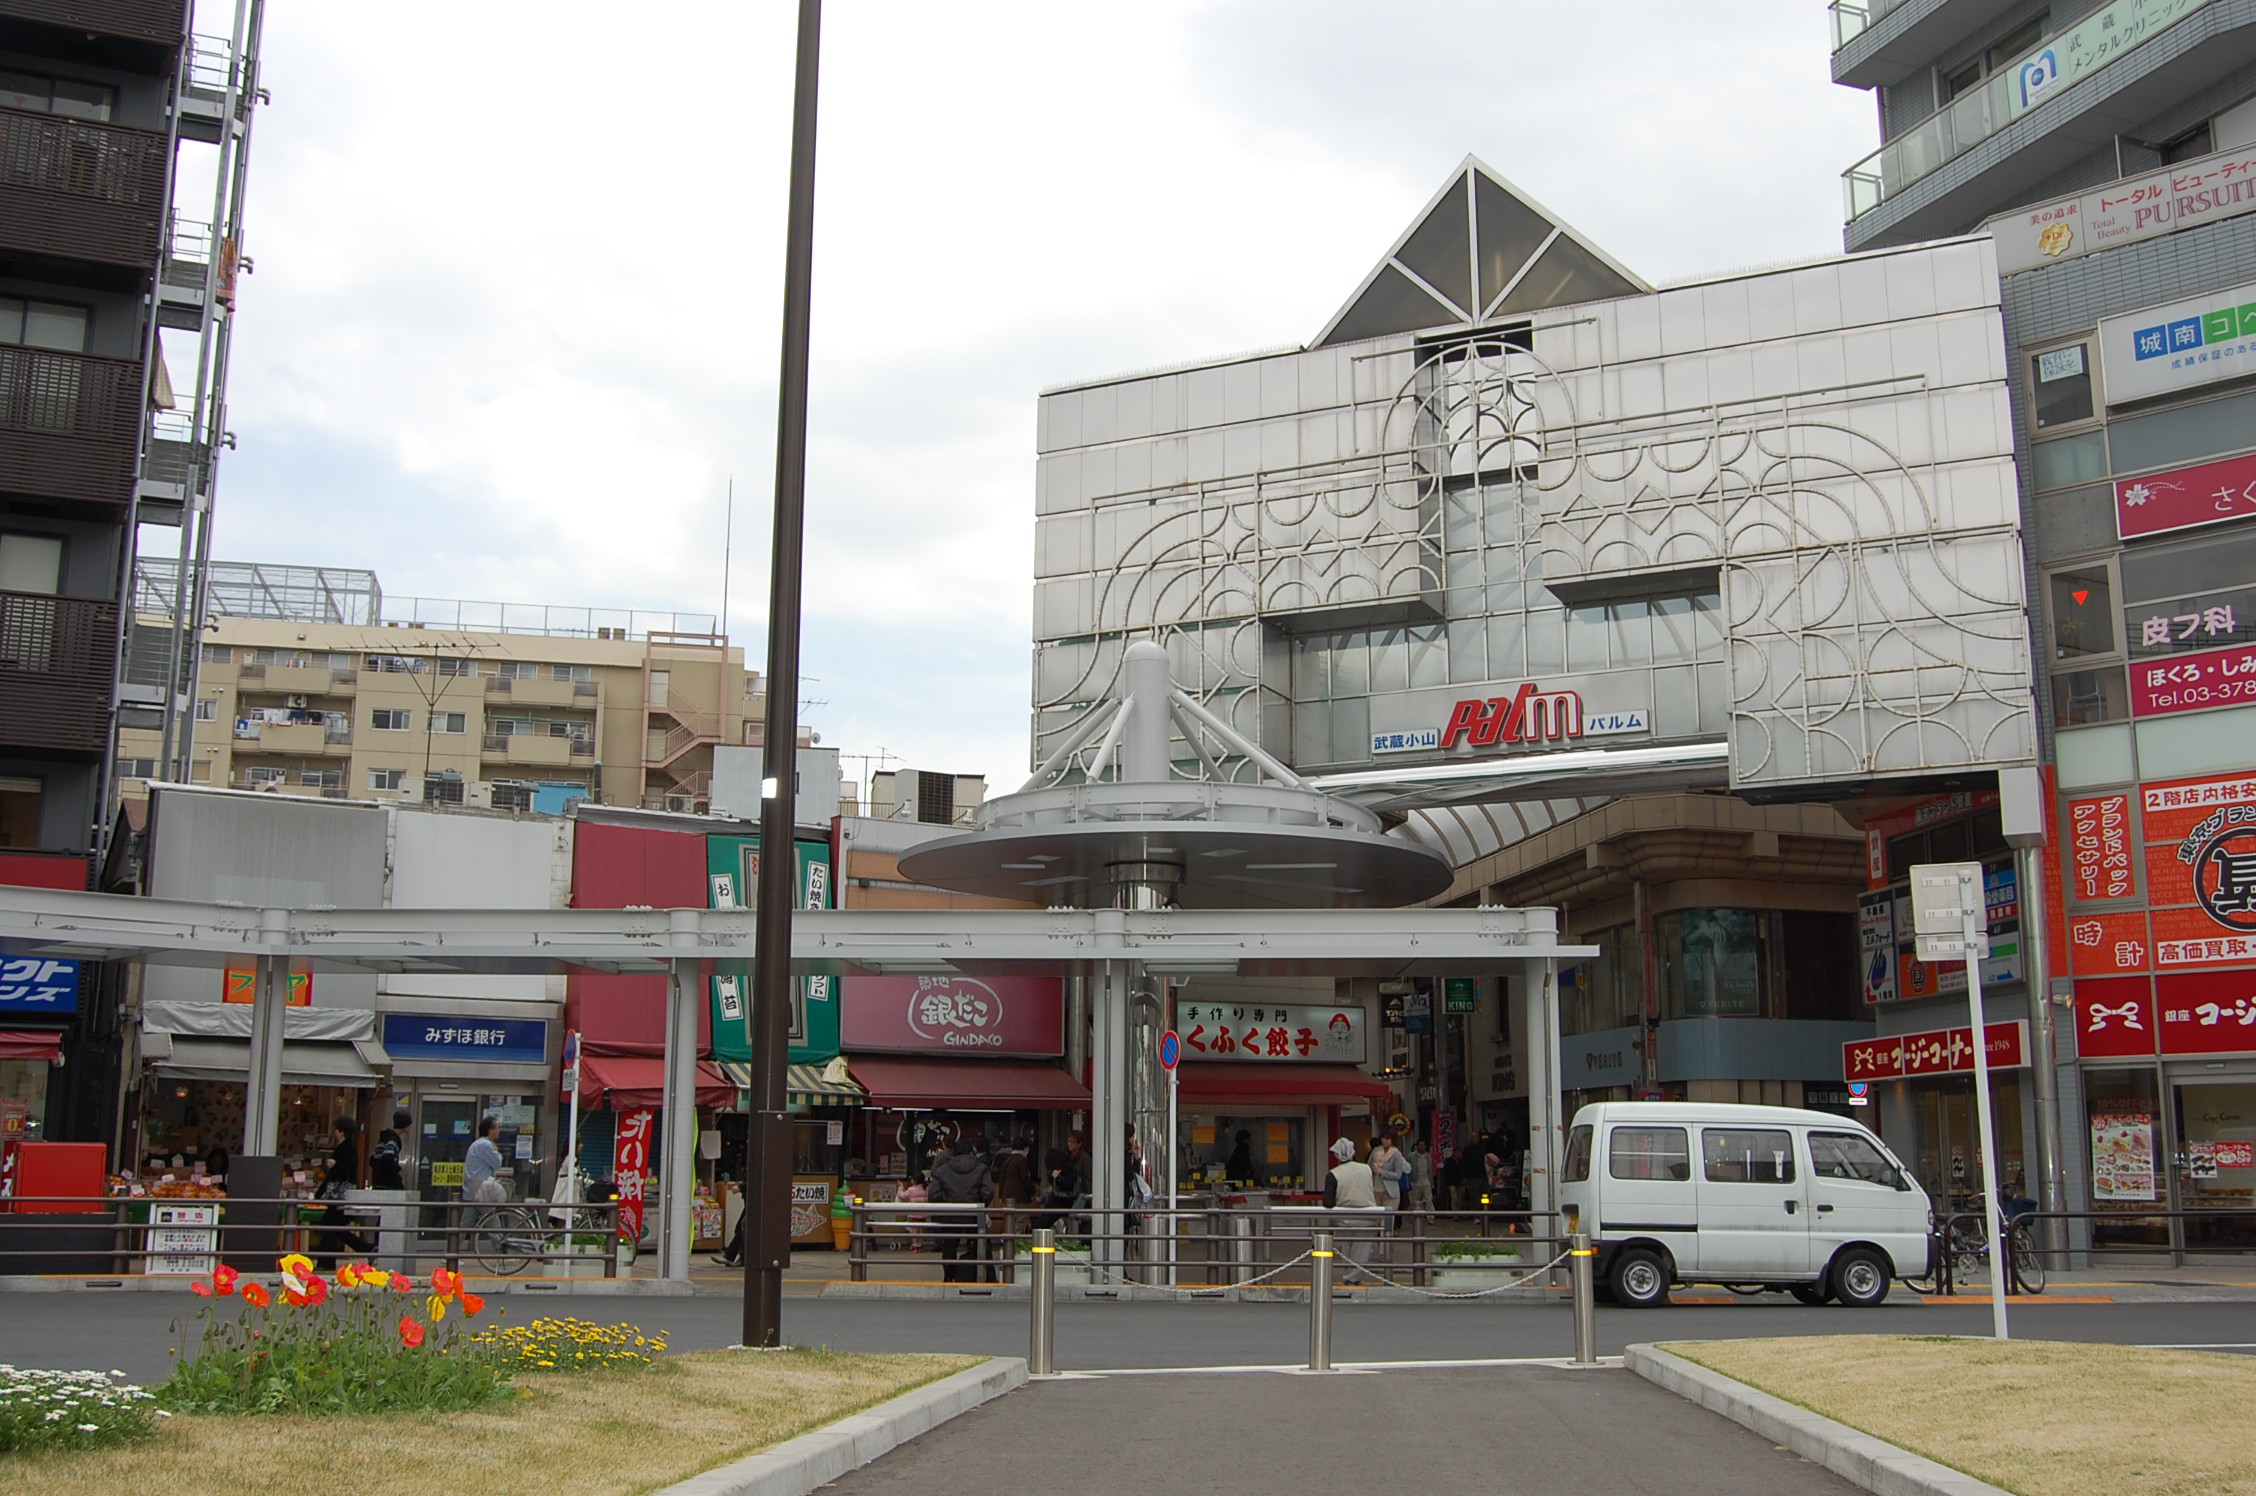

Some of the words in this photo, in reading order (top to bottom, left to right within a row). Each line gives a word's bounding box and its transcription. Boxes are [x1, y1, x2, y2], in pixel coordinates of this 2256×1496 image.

[2030, 203, 2078, 225] 美の追求
[2134, 177, 2256, 230] PURSUIT
[2091, 216, 2116, 231] Total
[2097, 223, 2131, 240] Beauty
[2142, 604, 2236, 647] 皮フ科
[1373, 731, 1436, 750] 武蔵小山
[1589, 713, 1642, 731] パルム
[2074, 804, 2100, 897] アクセサリー
[919, 989, 989, 1029] 銀だこ
[1187, 1006, 1288, 1023] 手作り専門
[1447, 1001, 1474, 1011] KING
[2164, 1009, 2190, 1022] 銀座
[425, 1027, 506, 1046] みずほ銀行
[943, 1031, 1003, 1046] GINDACO
[1186, 1024, 1319, 1057] くふく餃子
[1891, 1033, 1973, 1070] コージーコーナー
